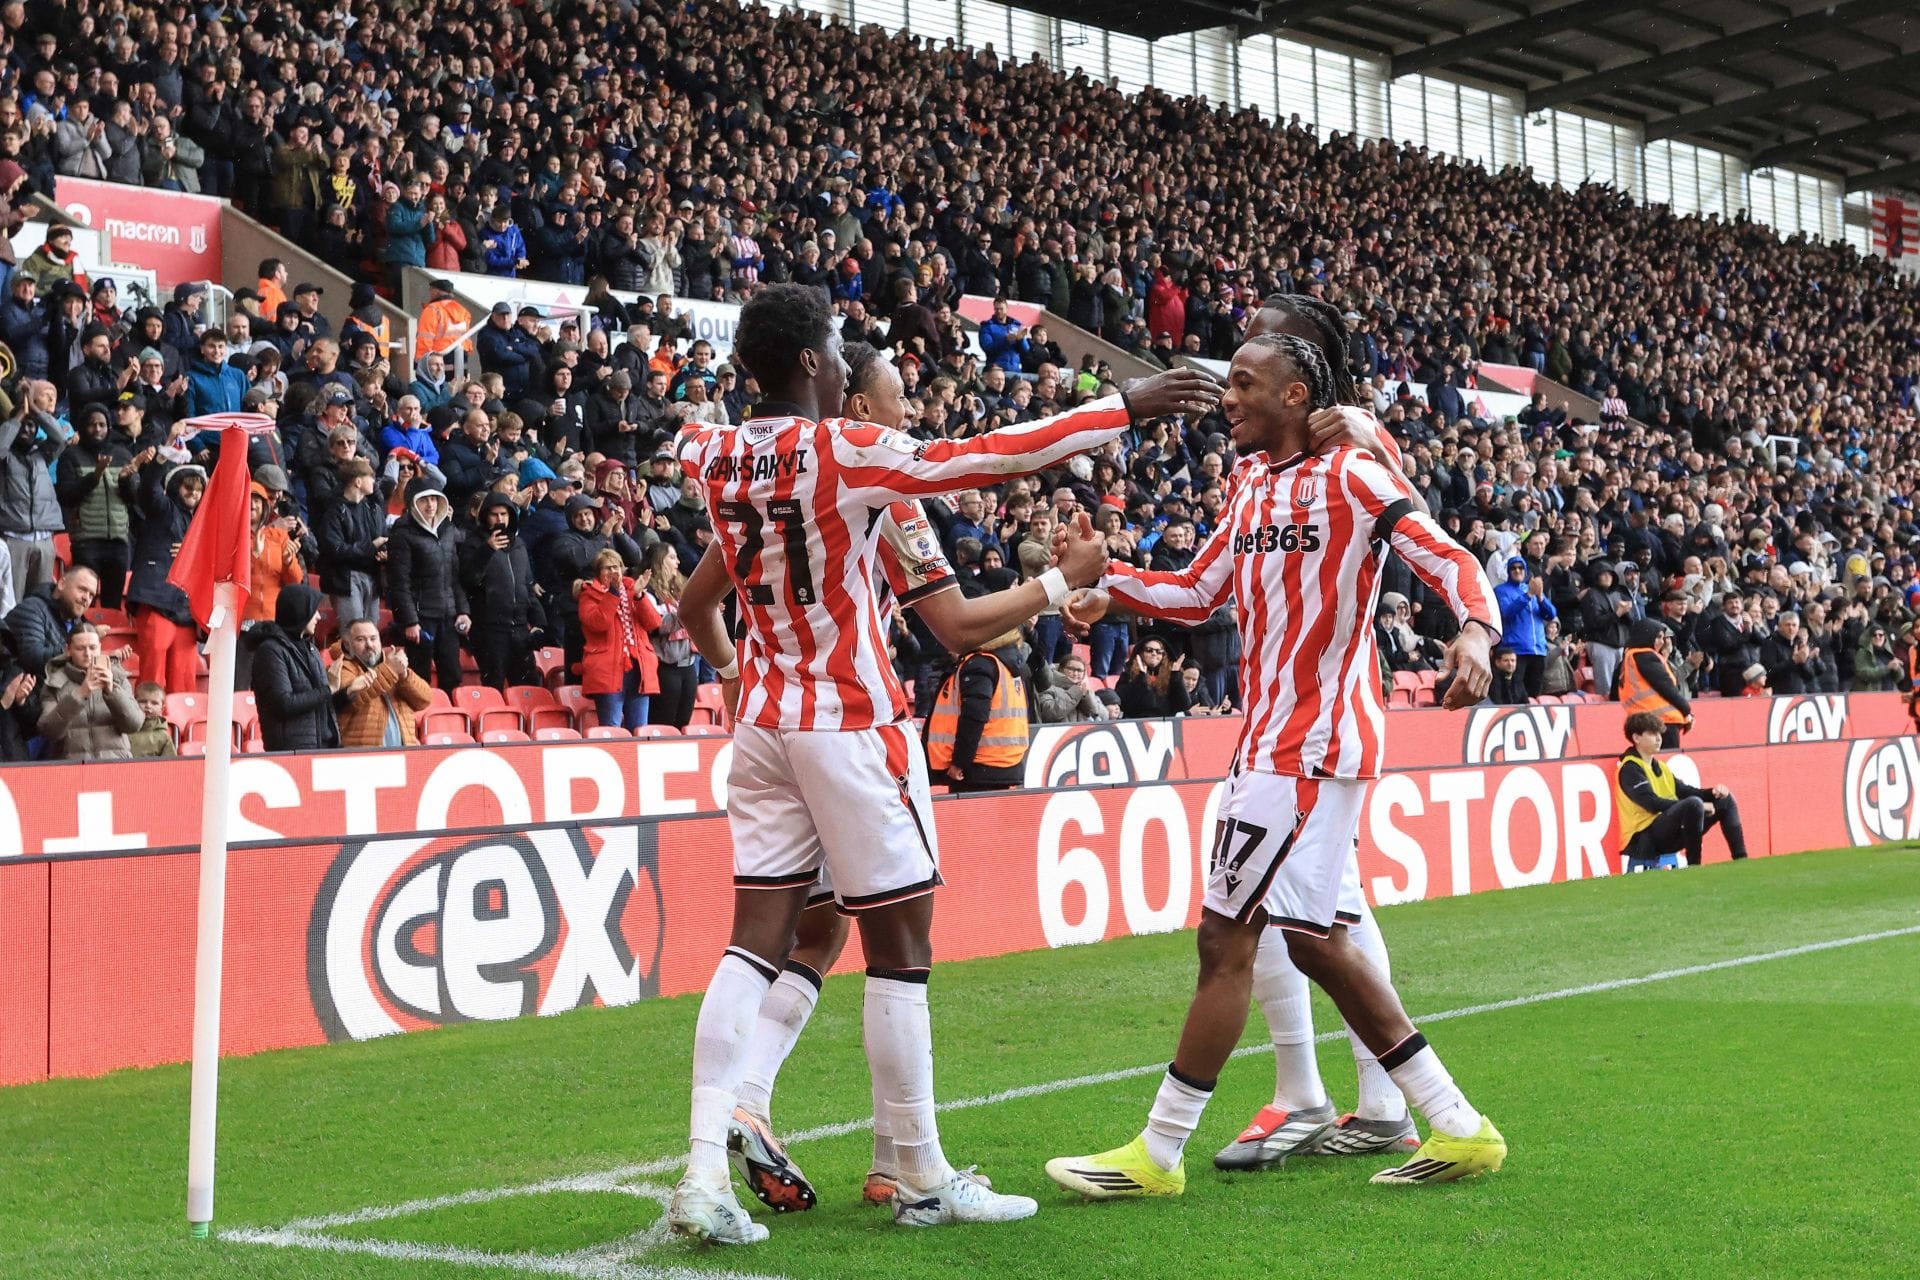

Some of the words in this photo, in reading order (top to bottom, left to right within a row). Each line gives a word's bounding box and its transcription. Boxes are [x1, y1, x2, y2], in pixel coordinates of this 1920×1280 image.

[105, 218, 180, 245] macron
[749, 426, 774, 435] STOKE
[704, 449, 808, 483] RAK-SAKYI
[904, 523, 917, 533] sky
[1233, 524, 1321, 556] bet365
[716, 499, 816, 606] 21
[1219, 817, 1267, 872] 17
